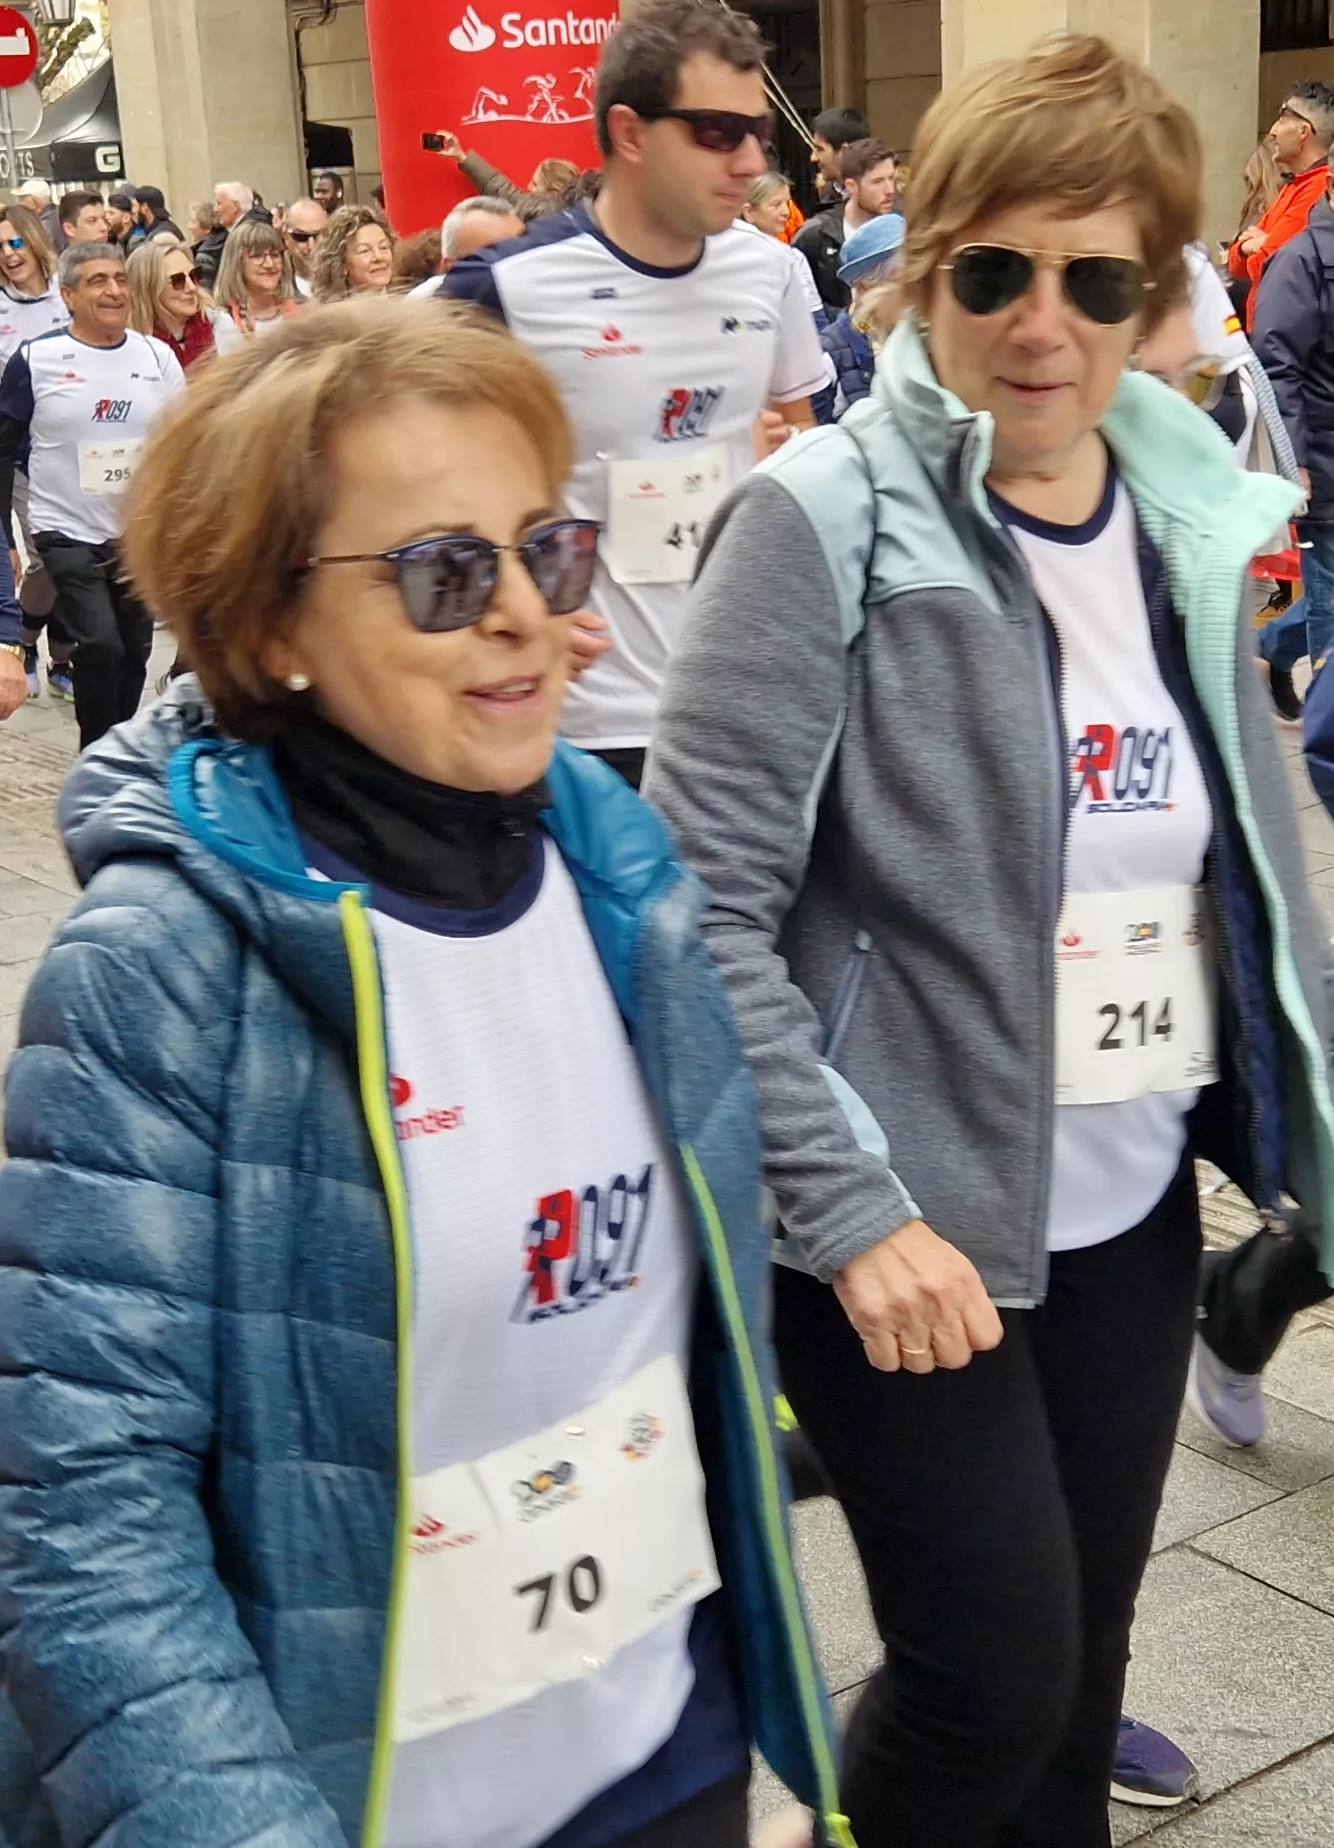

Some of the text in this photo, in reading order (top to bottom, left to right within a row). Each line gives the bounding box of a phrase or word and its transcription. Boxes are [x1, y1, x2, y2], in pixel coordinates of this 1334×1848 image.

[95, 145, 121, 172] G
[104, 468, 131, 483] 295
[1096, 996, 1174, 1050] 214
[513, 1554, 603, 1634] 70
